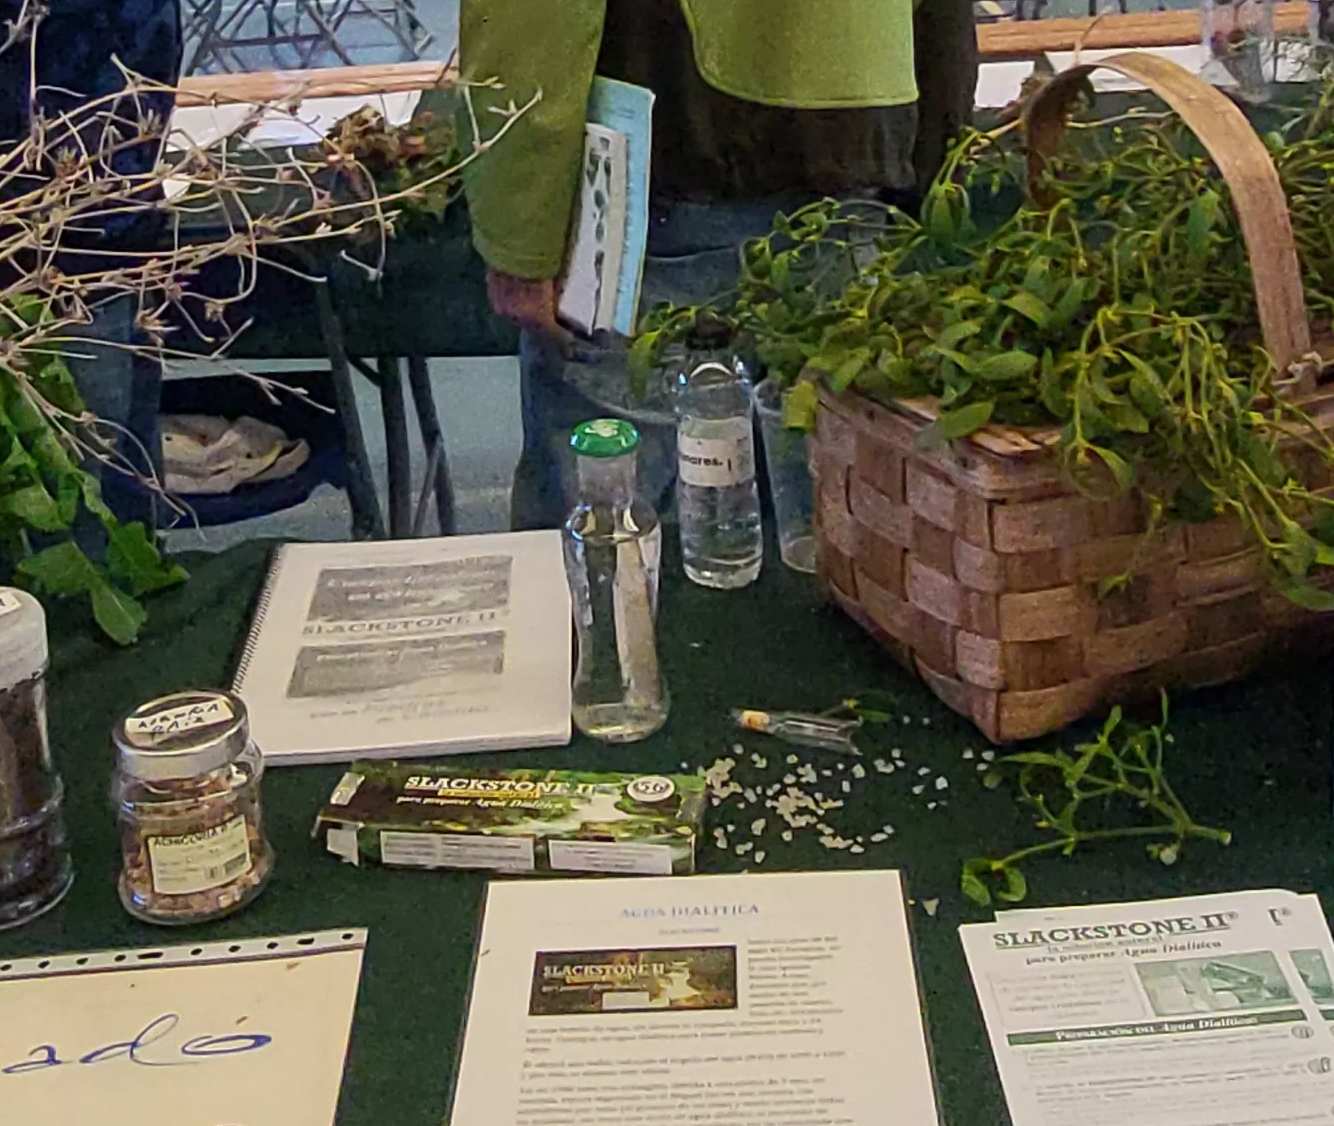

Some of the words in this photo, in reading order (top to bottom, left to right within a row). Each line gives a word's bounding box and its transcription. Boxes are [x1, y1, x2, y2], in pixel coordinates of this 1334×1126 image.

[404, 776, 572, 794] SLACKSTONE
[992, 917, 1198, 948] SLACKSTONE
[1025, 955, 1056, 966] para
[1058, 950, 1117, 965] preparar
[1120, 946, 1158, 960] Agua
